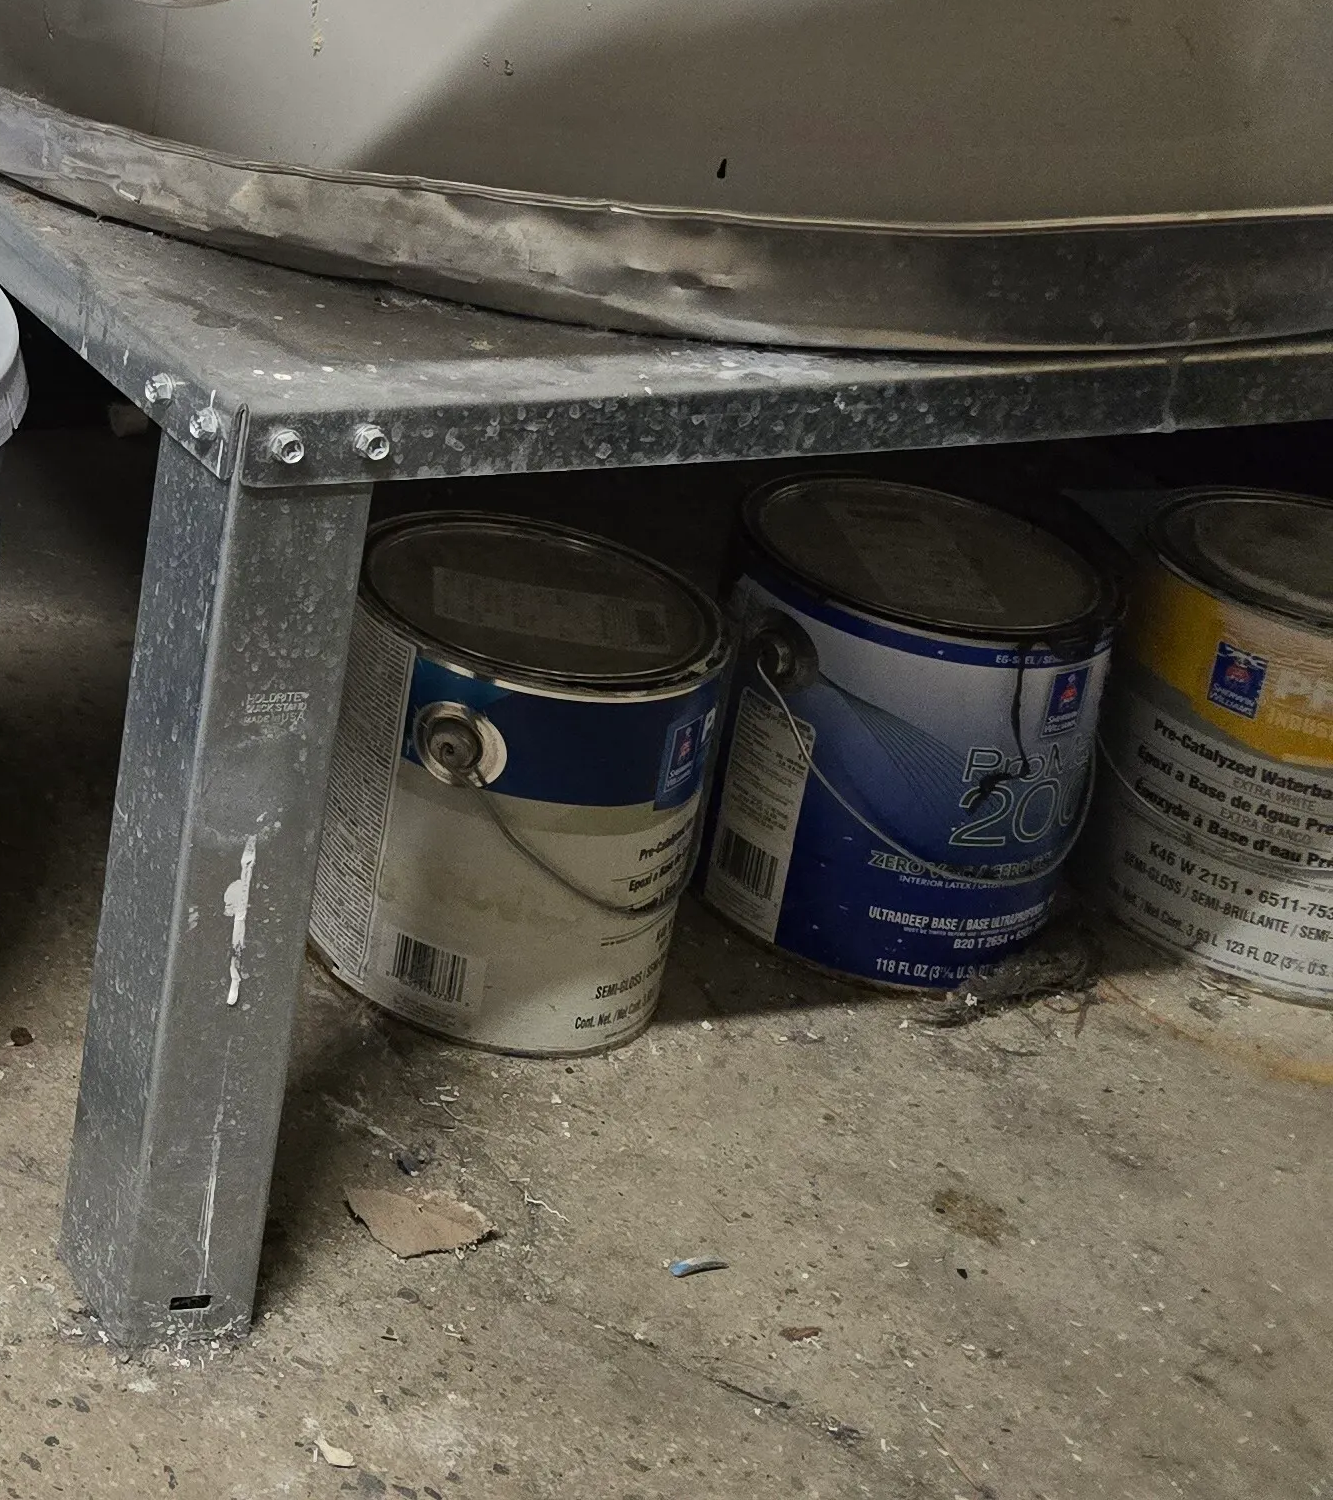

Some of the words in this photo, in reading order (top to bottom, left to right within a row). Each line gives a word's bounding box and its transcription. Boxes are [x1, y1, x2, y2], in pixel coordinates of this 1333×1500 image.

[1154, 718, 1258, 778] Pre-Catalyzed
[1189, 774, 1226, 802] Base
[1231, 796, 1251, 812] de
[1255, 804, 1300, 827] Agua
[1233, 778, 1271, 799] EXTRA
[1275, 789, 1317, 811] WHITE
[868, 850, 925, 876] ZERO
[1150, 842, 1175, 866] K46
[1181, 858, 1195, 875] W
[1198, 868, 1238, 895] 2151
[900, 875, 944, 887] INTERIOR
[869, 906, 929, 927] ULTRADEEP
[931, 916, 958, 930] BASE
[966, 919, 990, 930] BASE
[1190, 890, 1289, 934] SEMI-BRILLANTE
[953, 939, 975, 949] B20
[977, 938, 985, 948] T
[1226, 939, 1244, 955] 123
[1247, 946, 1259, 961] FL
[1263, 951, 1279, 966] OZ
[876, 958, 895, 973] 118
[898, 962, 910, 976] FL
[914, 965, 927, 977] OZ
